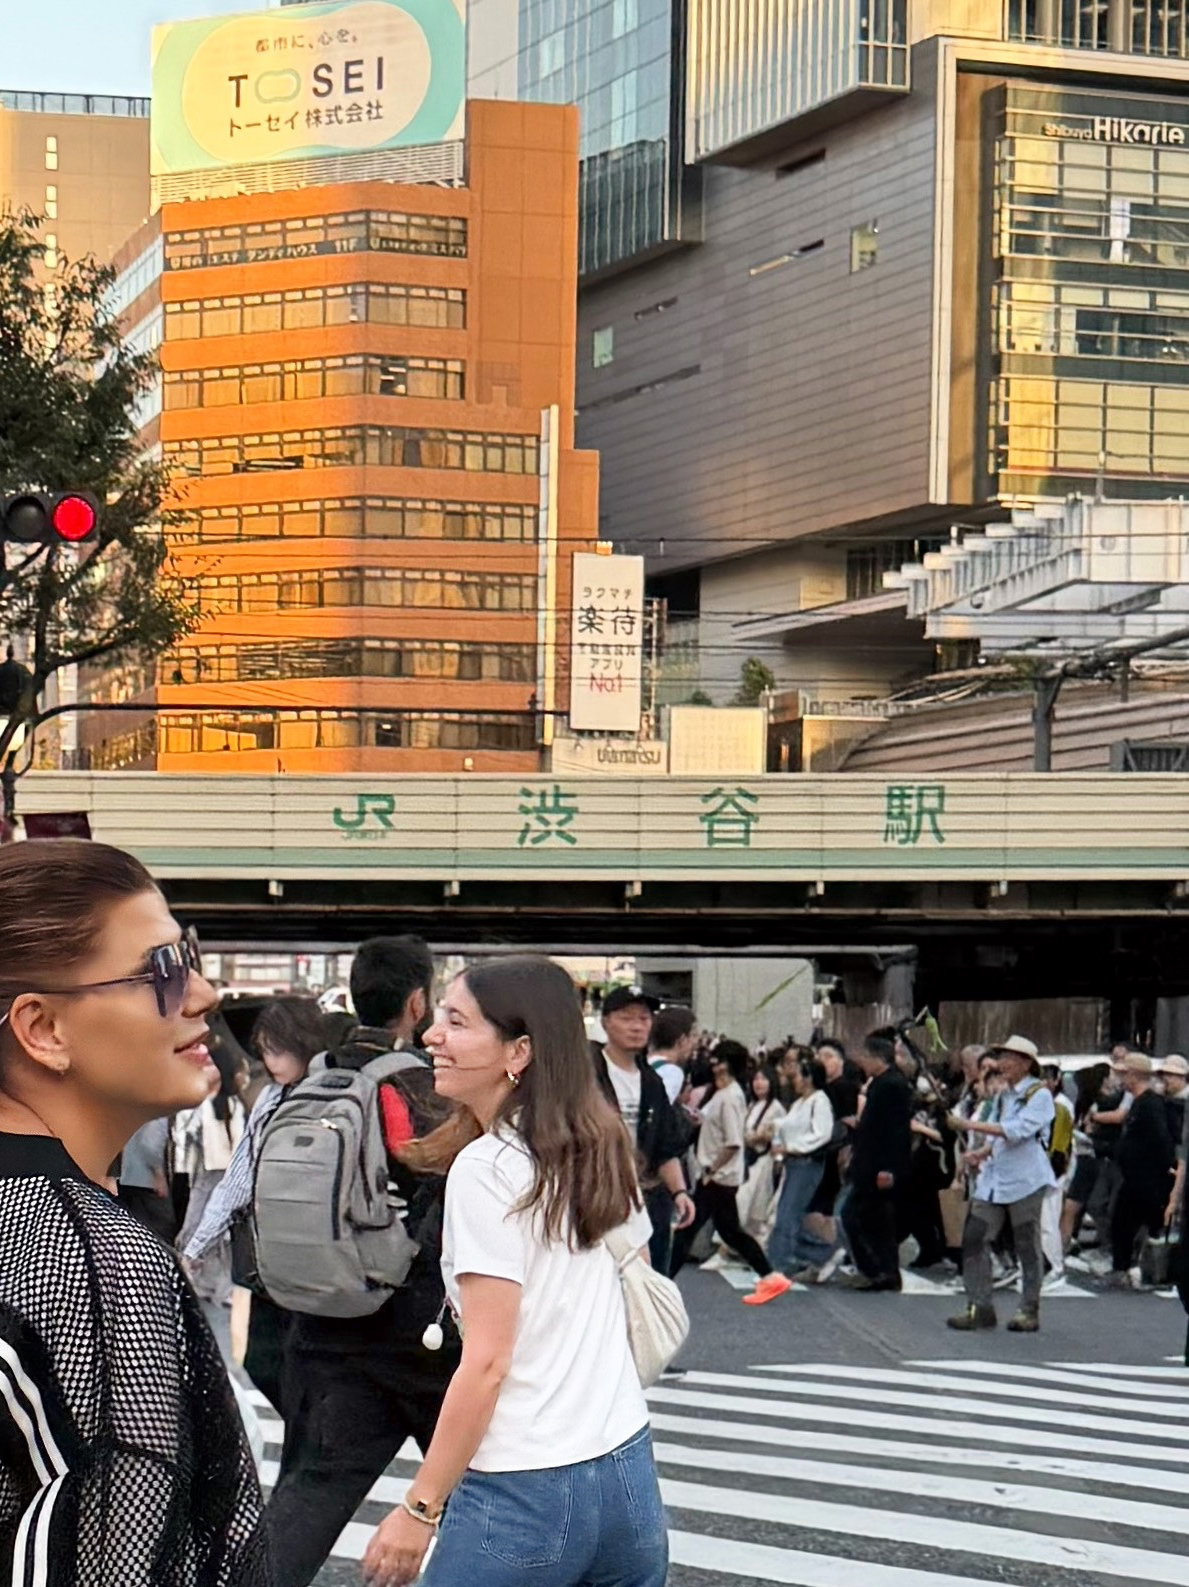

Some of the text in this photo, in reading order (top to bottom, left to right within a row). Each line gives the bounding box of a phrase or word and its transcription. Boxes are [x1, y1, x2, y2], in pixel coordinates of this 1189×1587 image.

[228, 56, 384, 108] TOSEI
[229, 99, 384, 137] トーセイ株式会社
[1093, 116, 1185, 144] Hikarie
[577, 604, 636, 635] 楽待
[333, 793, 395, 830] JR
